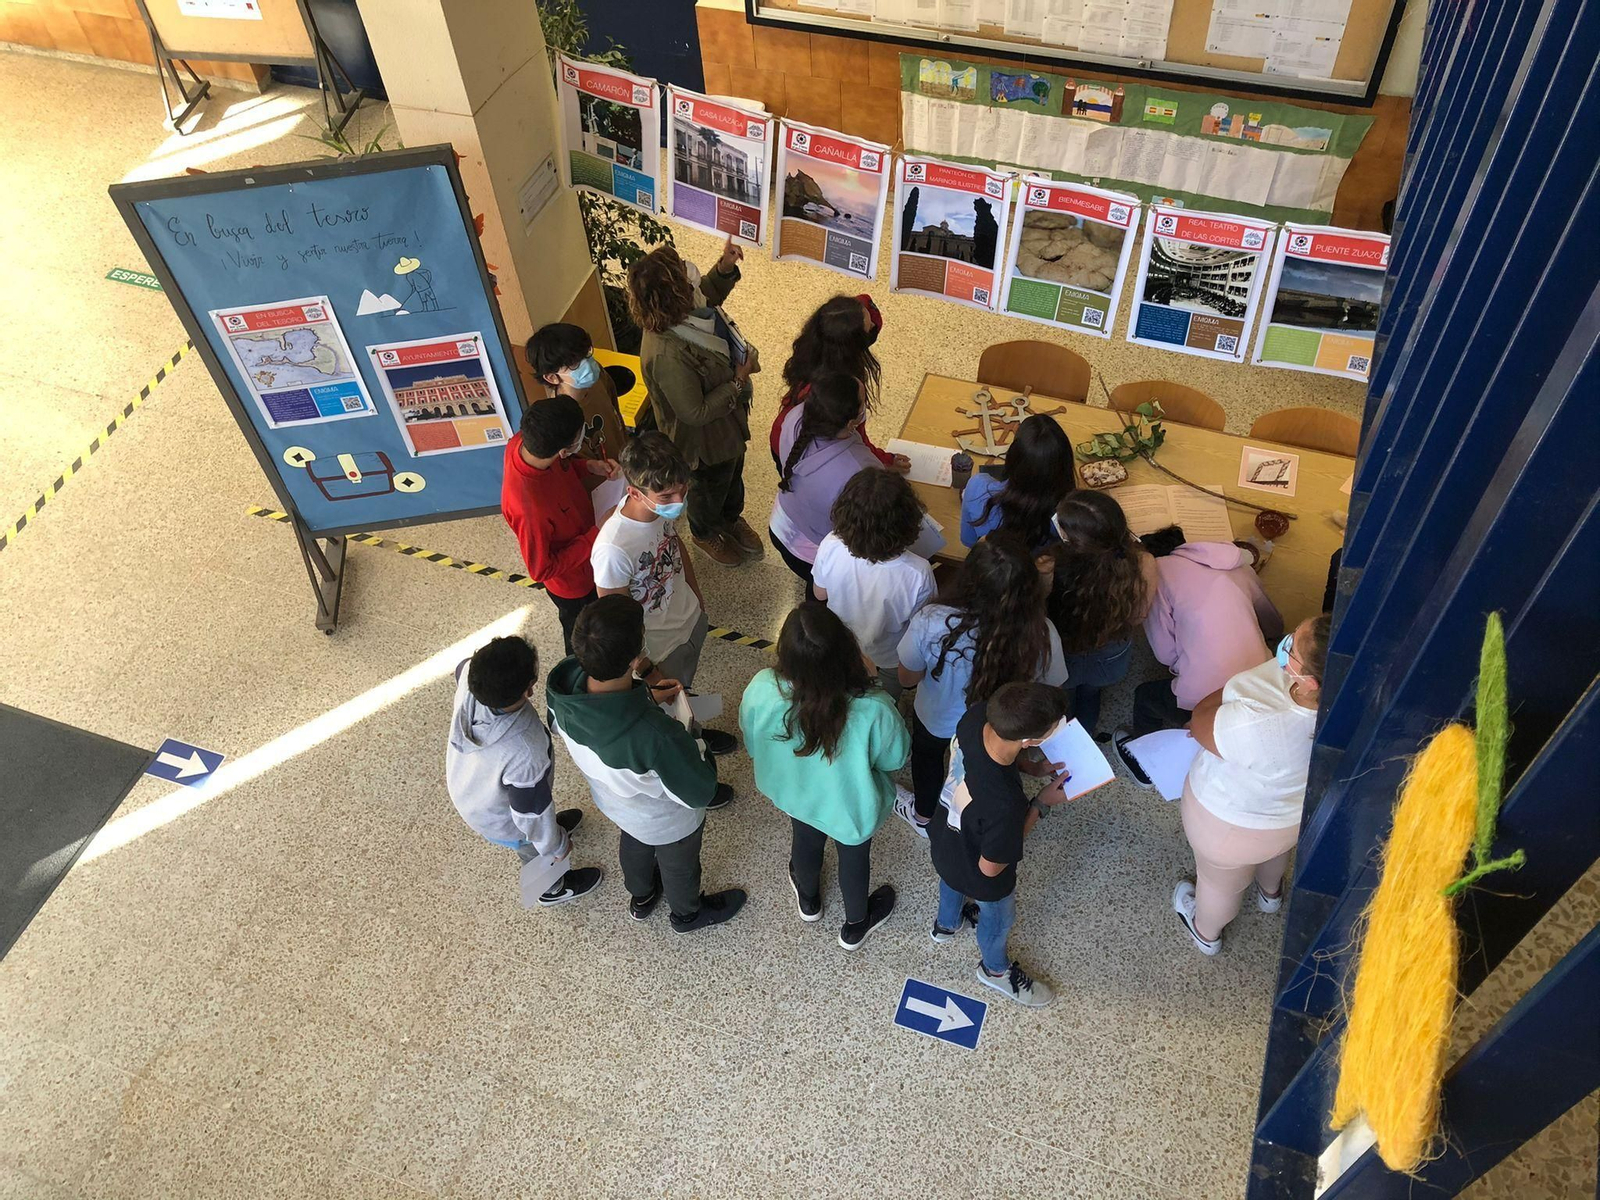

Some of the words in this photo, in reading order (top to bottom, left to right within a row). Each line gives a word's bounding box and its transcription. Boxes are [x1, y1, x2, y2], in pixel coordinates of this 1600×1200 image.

[586, 80, 630, 97] CAMARÓN
[700, 109, 718, 120] CASA
[718, 115, 744, 128] LAZAGA
[814, 144, 857, 162] CAÑAILLA
[938, 167, 967, 179] PANTEÓN
[929, 175, 958, 187] MARINOS
[720, 200, 742, 212] ENIGMA
[1058, 196, 1105, 213] BIENMESABE
[167, 216, 197, 246] En
[206, 213, 254, 242] busca
[265, 209, 294, 234] del
[306, 203, 369, 227] tesoro
[1188, 218, 1207, 228] REAL
[1209, 221, 1239, 232] TEATRO
[829, 234, 852, 247] ENIGMA
[1193, 232, 1208, 240] LAS
[1208, 235, 1240, 246] CORTES
[276, 254, 288, 271] y
[297, 244, 327, 263] sentir
[334, 238, 370, 254] nuestra
[1315, 244, 1350, 256] PUENTE
[1351, 248, 1382, 260] ZUAZO
[1064, 289, 1090, 300] ENIGMA
[267, 309, 294, 317] BUSCA
[272, 316, 303, 326] TESORO
[1193, 315, 1219, 325] ENIGMA
[402, 349, 459, 361] AYUNTAMIENTO
[313, 386, 338, 394] ENIGMA
